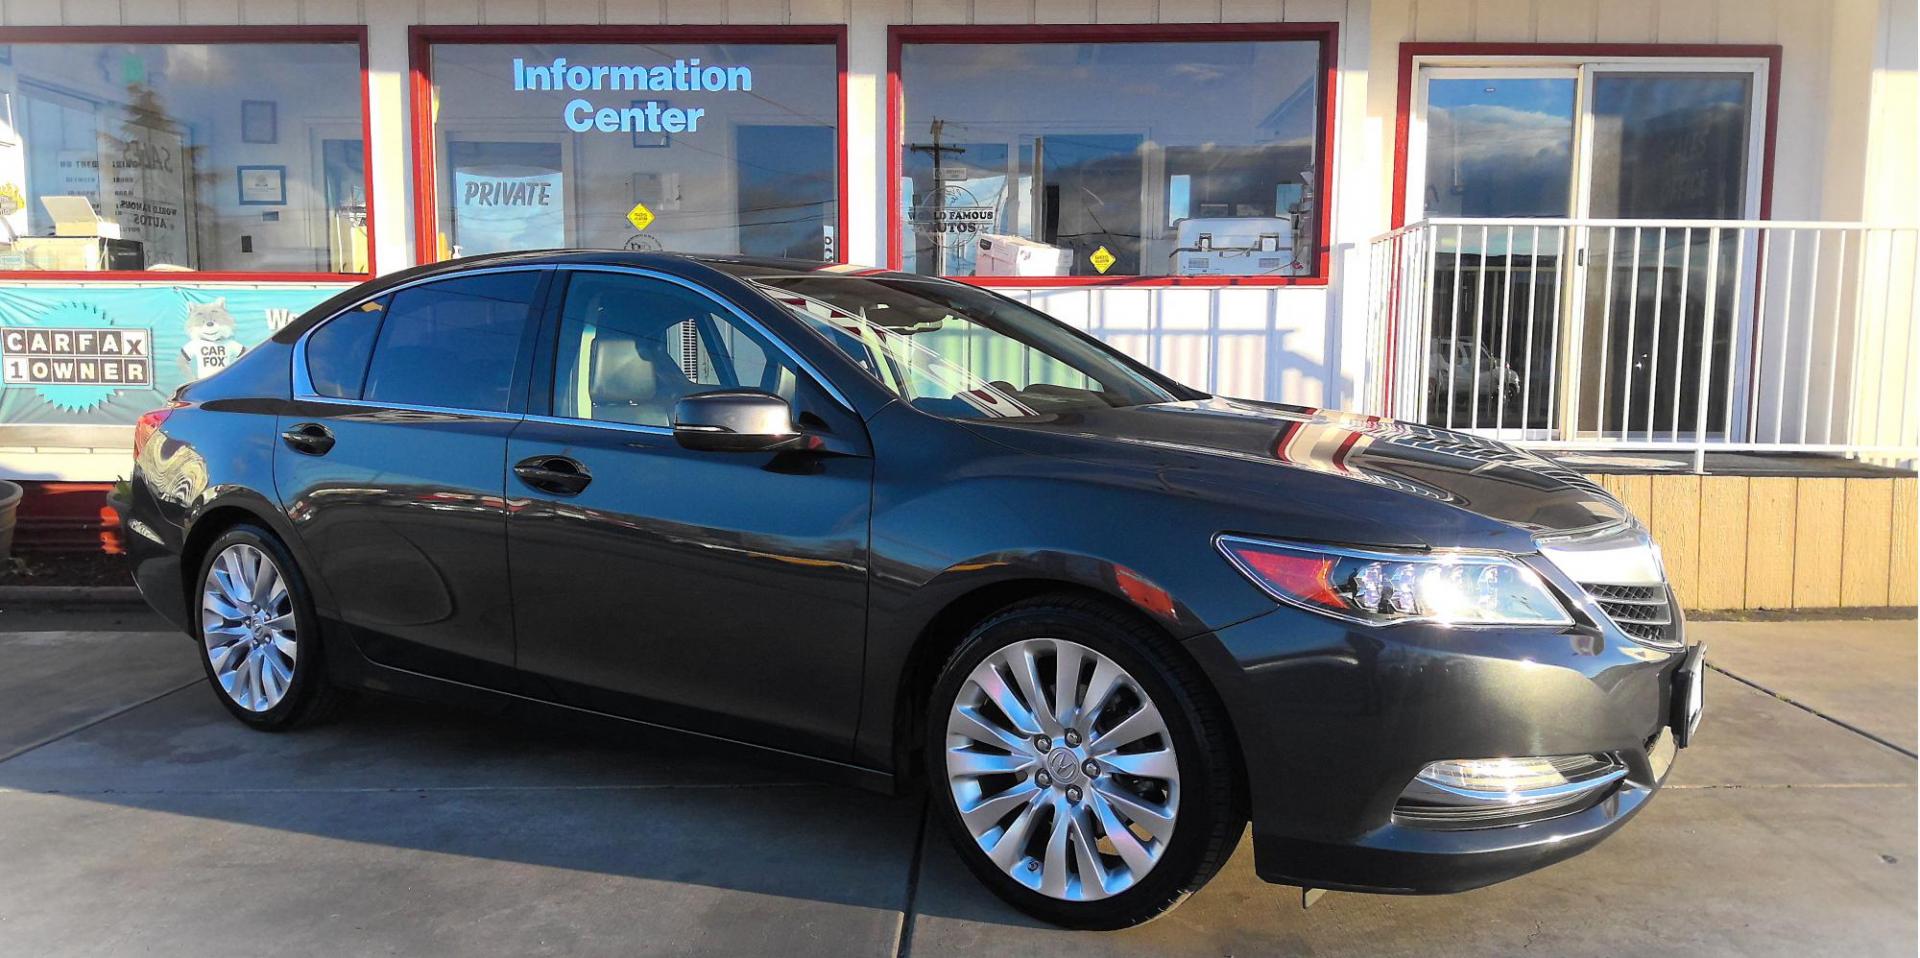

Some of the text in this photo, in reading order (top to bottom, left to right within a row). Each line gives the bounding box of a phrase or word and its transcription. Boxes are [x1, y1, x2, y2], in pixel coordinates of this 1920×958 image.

[513, 57, 752, 92] Information
[564, 99, 704, 133] Center
[464, 181, 552, 207] PRIVATE
[949, 211, 993, 221] FAMOUS
[6, 332, 142, 356] CARFAX
[200, 346, 226, 357] CAR
[203, 356, 226, 368] FOX
